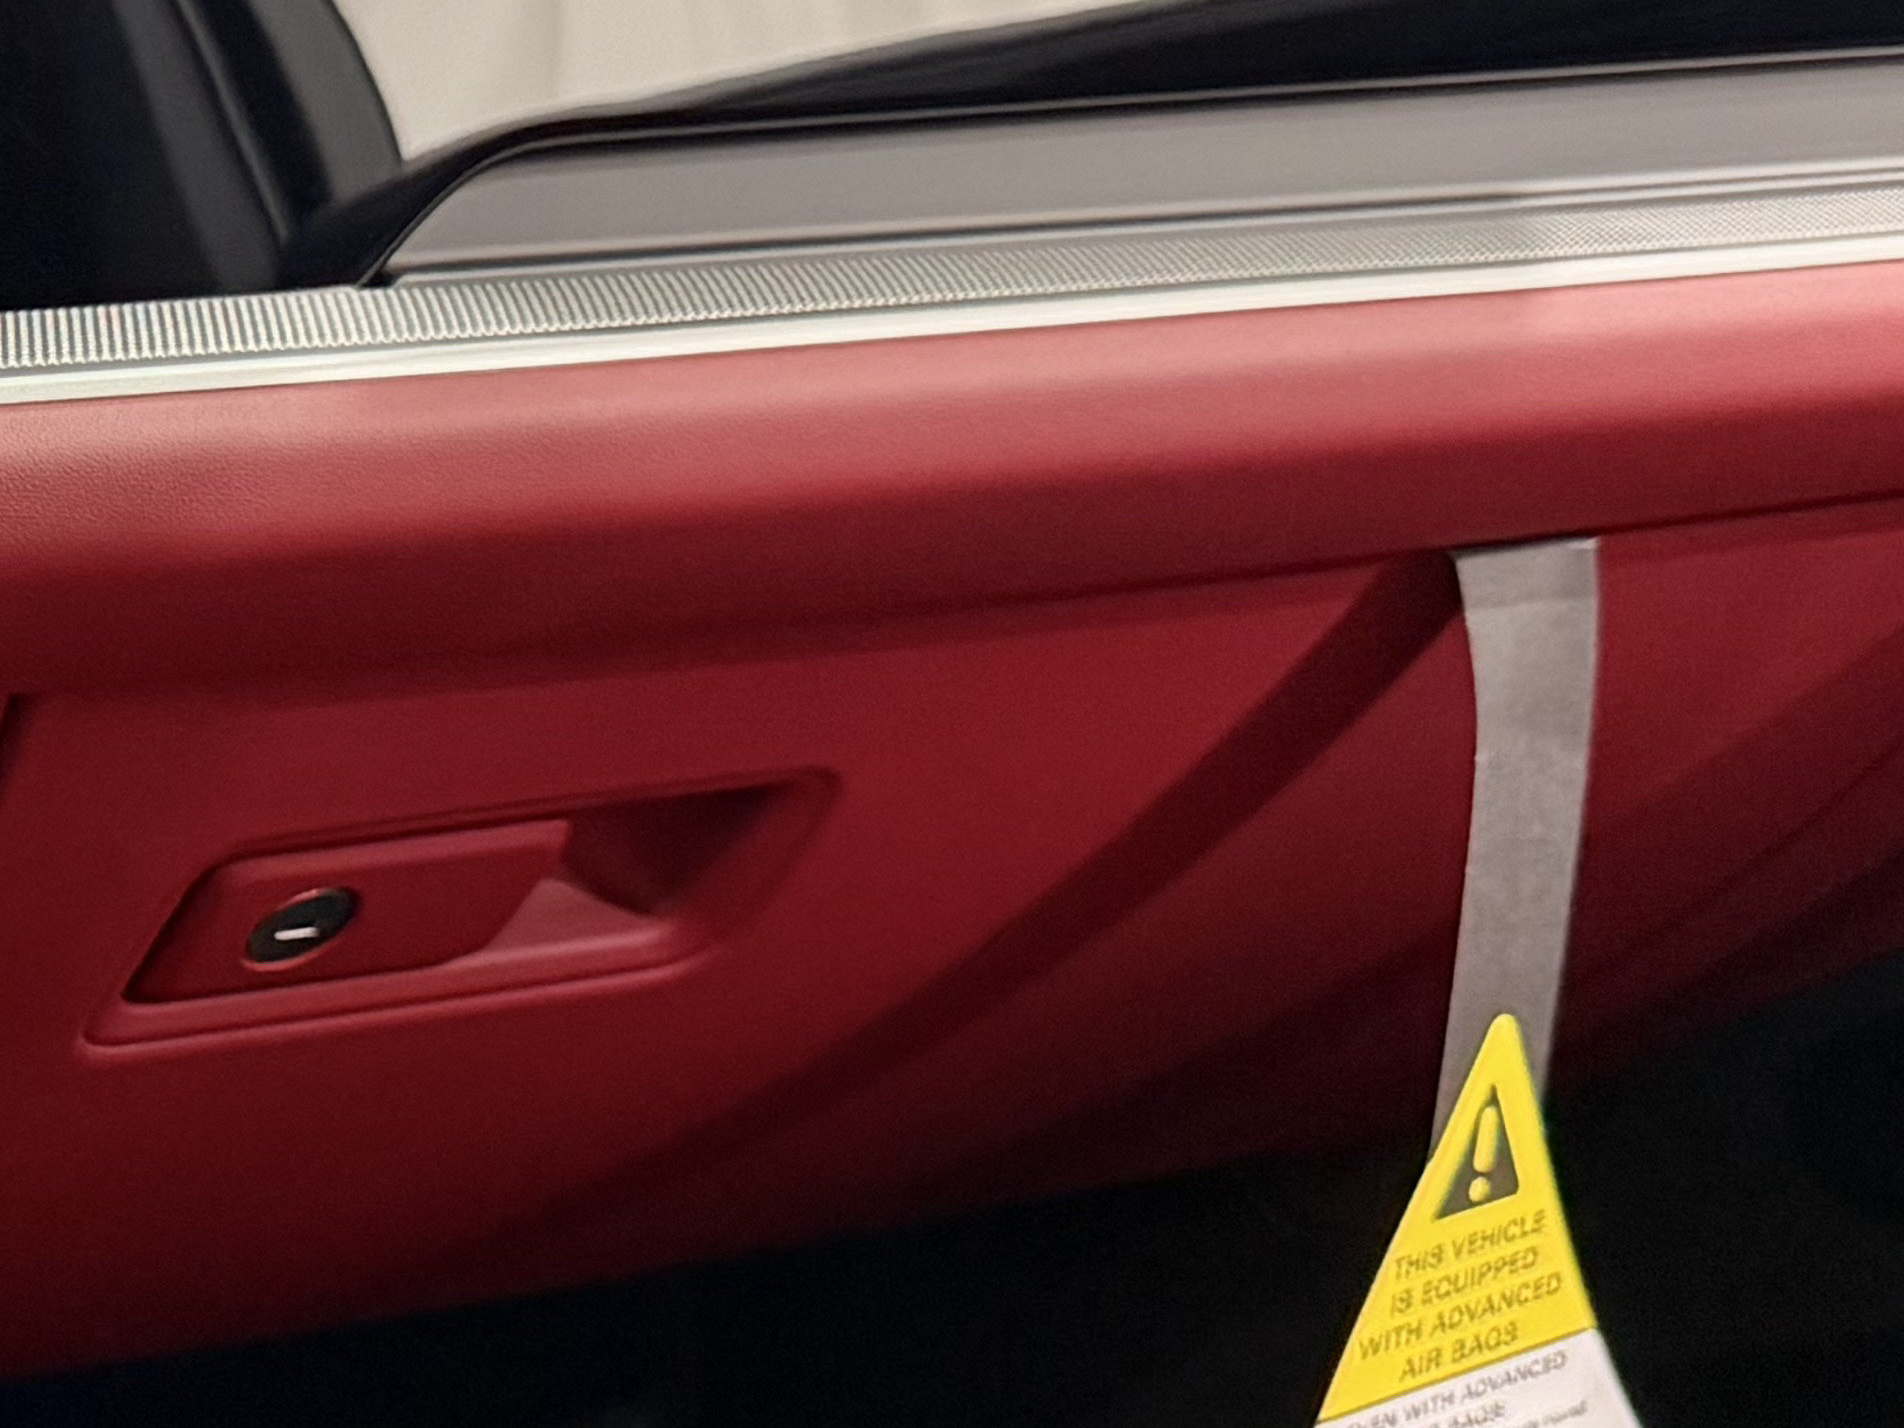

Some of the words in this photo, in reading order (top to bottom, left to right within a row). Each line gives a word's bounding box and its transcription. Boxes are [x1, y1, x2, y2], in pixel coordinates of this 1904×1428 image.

[1393, 1242, 1445, 1281] THIS
[1451, 1208, 1547, 1260] VEHICLE
[1420, 1245, 1539, 1306] EQUIPPED
[1358, 1320, 1424, 1361] WITH
[1429, 1271, 1563, 1337] ADVANCED
[1398, 1346, 1443, 1383] AIR
